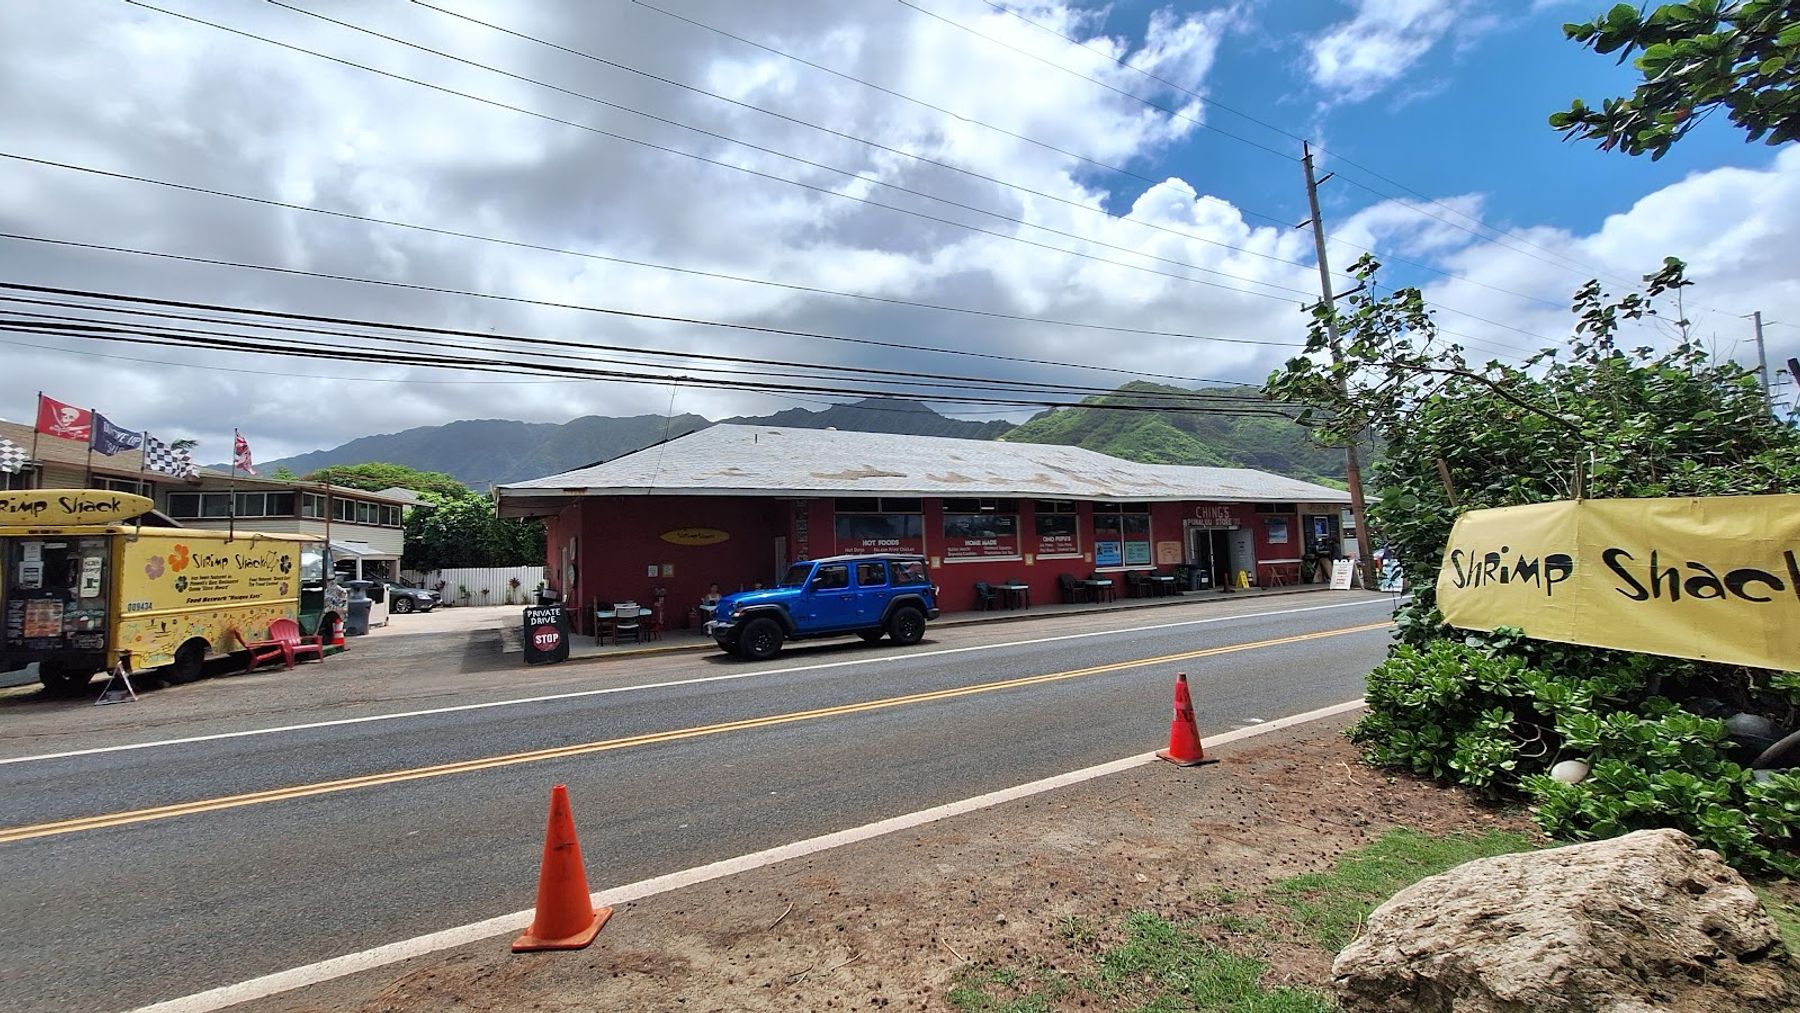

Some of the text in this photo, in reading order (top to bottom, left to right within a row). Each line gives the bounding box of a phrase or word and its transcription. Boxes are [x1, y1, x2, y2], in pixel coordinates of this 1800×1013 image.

[58, 497, 121, 514] Shack
[235, 553, 265, 570] Shack
[527, 608, 560, 617] PRIVATE
[531, 616, 557, 625] DRIVE
[535, 633, 559, 644] STOP
